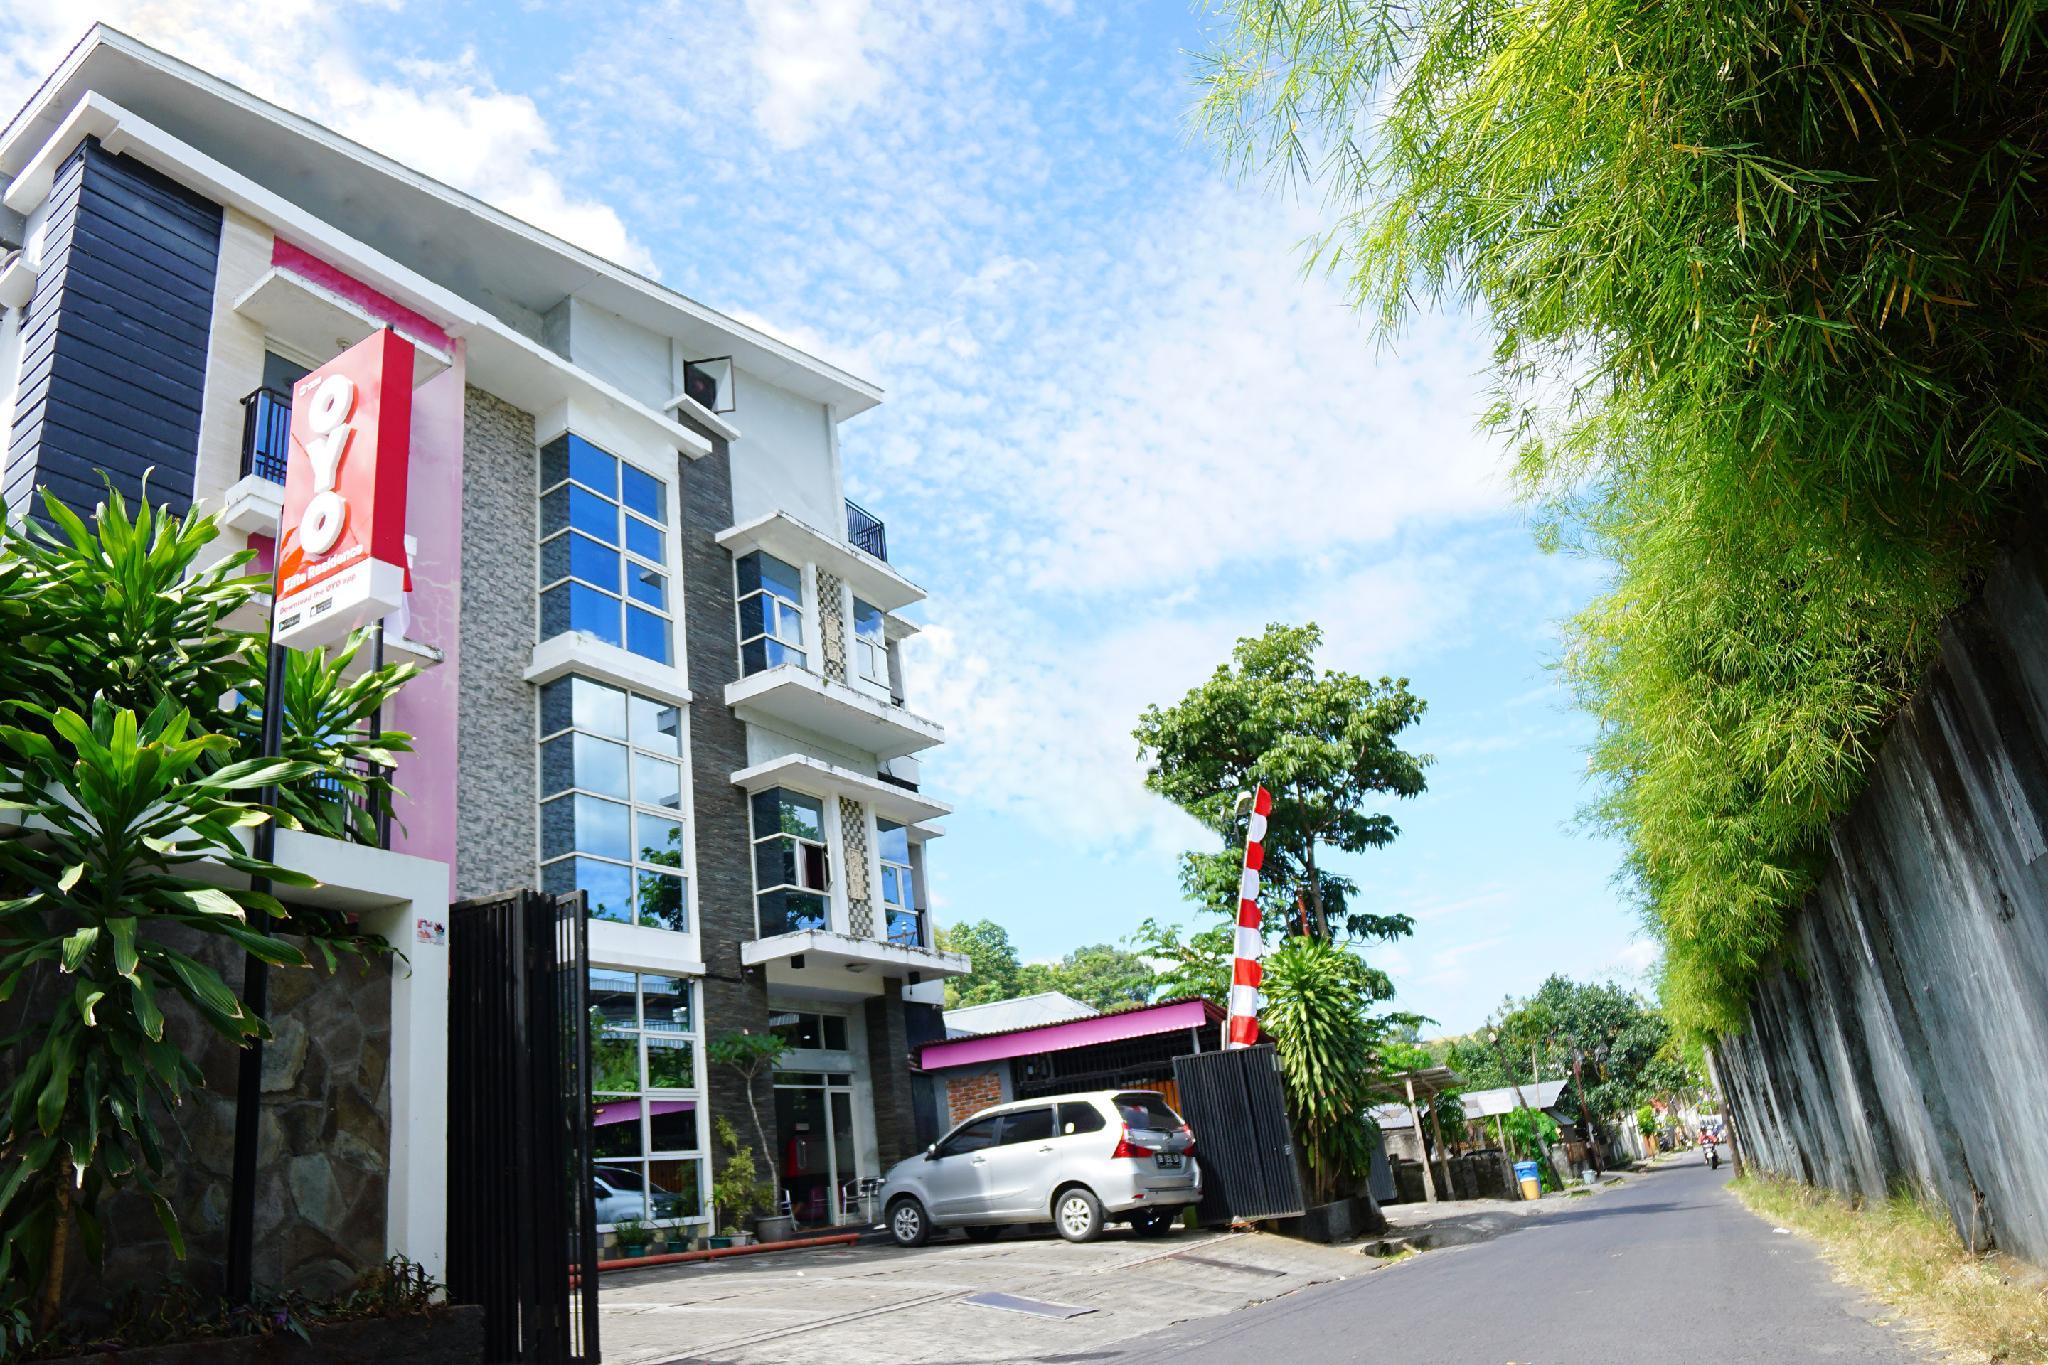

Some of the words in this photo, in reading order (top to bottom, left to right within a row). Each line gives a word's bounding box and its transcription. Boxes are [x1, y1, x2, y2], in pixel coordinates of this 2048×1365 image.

[301, 374, 354, 554] OYO
[307, 544, 363, 579] Residence
[325, 579, 341, 593] OYO
